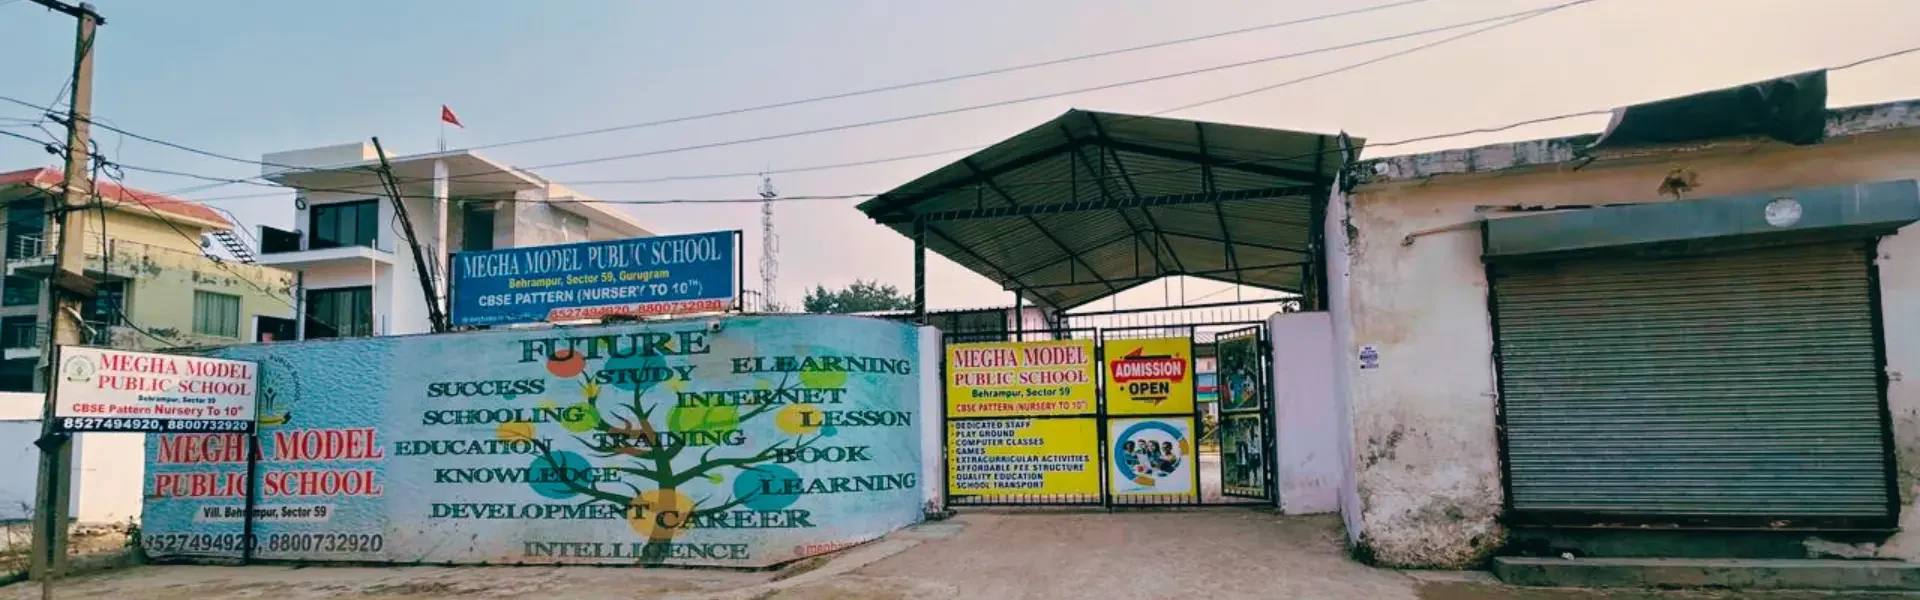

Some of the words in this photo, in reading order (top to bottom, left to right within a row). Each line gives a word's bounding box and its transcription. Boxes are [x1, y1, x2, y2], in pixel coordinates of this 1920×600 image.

[463, 252, 520, 279] MEGHA
[524, 248, 583, 274] MODEL
[588, 242, 646, 269] PUBLIC
[651, 236, 721, 265] SCHOOL
[508, 276, 564, 289] Behrampur,
[567, 273, 598, 285] Sector
[619, 269, 670, 282] Gurugram
[478, 294, 512, 307] CBSE
[515, 290, 574, 304] PATTERN
[577, 283, 645, 304] (NURSERY
[649, 284, 668, 296] TO
[518, 330, 710, 363] FUTURE
[730, 356, 912, 376] ELEARNING
[954, 348, 1018, 368] MEGHA
[1024, 346, 1088, 367] MODEL
[100, 354, 178, 375] MEGHA
[186, 361, 252, 379] MODEL
[595, 365, 697, 384] STUDY
[1115, 361, 1182, 378] ADMISSION
[98, 375, 172, 391] PUBLIC
[178, 380, 251, 396] SCHOOL
[954, 371, 1013, 386] PUBLIC
[1019, 370, 1088, 385] SCHOOL
[427, 379, 545, 397] SUCCESS
[971, 389, 1024, 399] Behrampur,
[1026, 387, 1057, 397] Sector
[1059, 387, 1070, 396] 59
[1128, 381, 1170, 395] OPEN
[676, 388, 847, 408] INTERNET
[956, 403, 976, 413] CBSE
[979, 402, 1014, 412] PATTERN
[1059, 401, 1070, 410] TO
[72, 403, 105, 413] CBSE
[109, 404, 150, 414] Pattern
[154, 404, 203, 417] Nursery
[207, 406, 222, 416] To
[422, 407, 585, 425] SCHOOLING
[799, 410, 912, 427] LESSON
[63, 417, 163, 431] 8527494920,
[167, 420, 248, 431] 8800732920
[955, 421, 1003, 430] DEDICATED
[1005, 420, 1031, 429] STAFF
[593, 430, 747, 449] TRAINING
[955, 430, 976, 438] PLAY
[979, 429, 1015, 437] GROUND
[956, 438, 1003, 446] COMPUTER
[1006, 438, 1045, 446] CLASSES
[274, 429, 383, 460] MODEL
[394, 438, 554, 456] EDUCATION
[956, 447, 986, 455] GAMES
[773, 445, 872, 464] BOOK
[956, 455, 1039, 464] EXTRACURRICULAR
[1041, 454, 1090, 462] ACTIVITIES
[433, 467, 623, 484] KNOWLEDGE
[956, 464, 1010, 472] AFFORDABLE
[1013, 464, 1030, 472] FEE
[1032, 463, 1084, 472] STRUCTURE
[956, 473, 991, 481] QUALITY
[994, 472, 1044, 481] EDUCATION
[155, 471, 249, 499] PUBLIC
[264, 470, 382, 496] SCHOOL
[759, 472, 917, 496] LEARNING
[956, 481, 990, 489] SCHOOL
[993, 481, 1044, 489] TRANSPORT
[224, 507, 279, 520] Behmpur,
[281, 506, 312, 517] Sector
[314, 506, 327, 516] 59
[428, 502, 650, 520] DEVELOPMENT
[655, 509, 817, 529] CAREER
[269, 533, 383, 551] 8800732920
[523, 541, 751, 561] INTELLIGENCE
